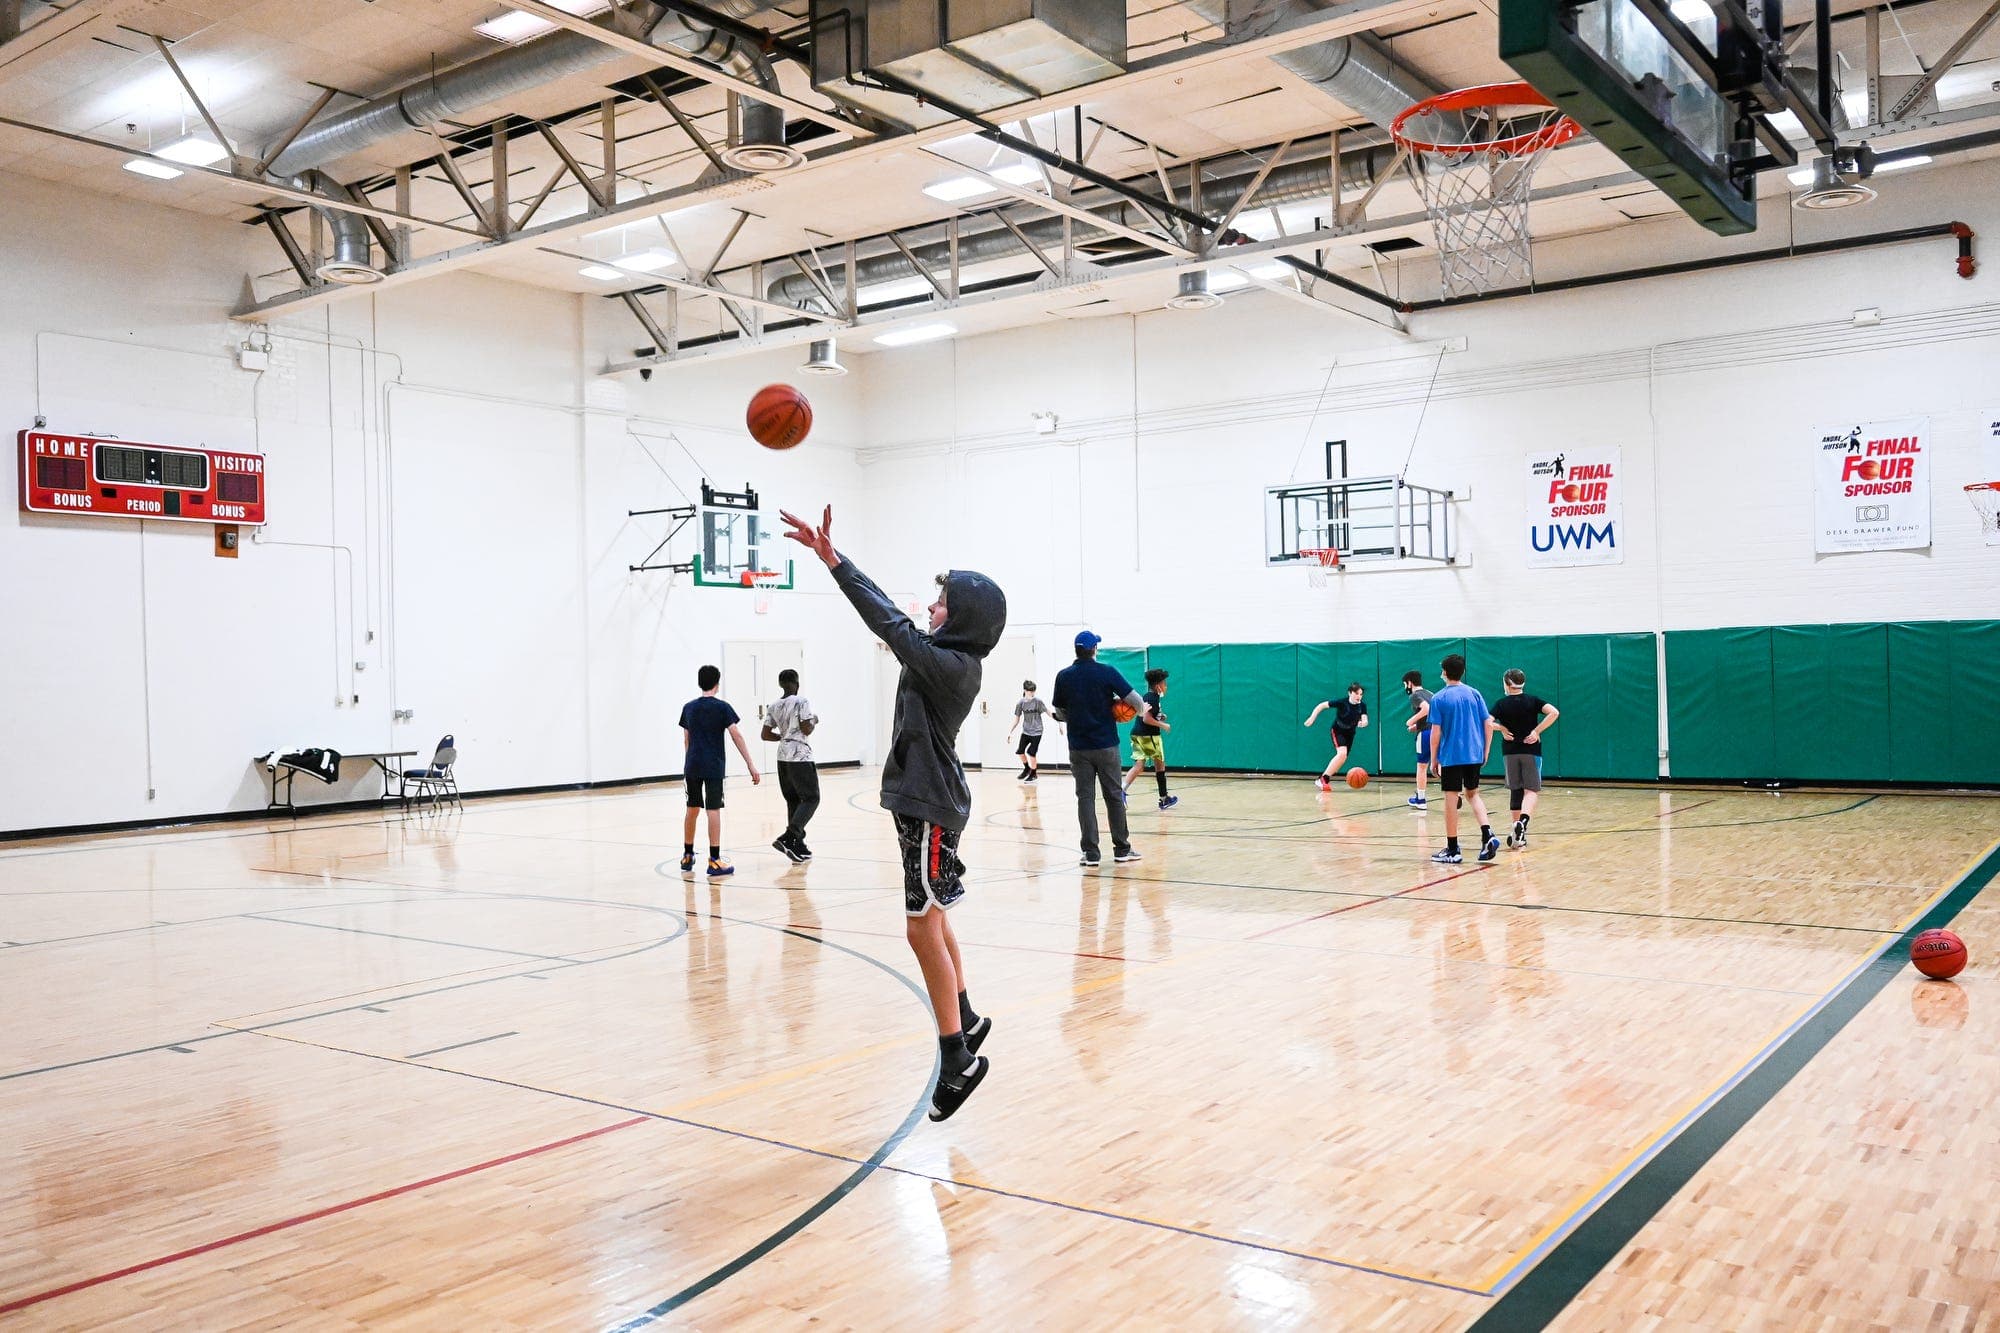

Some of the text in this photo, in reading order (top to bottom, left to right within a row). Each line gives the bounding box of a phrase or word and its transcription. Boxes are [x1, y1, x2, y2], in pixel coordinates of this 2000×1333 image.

[36, 438, 88, 457] HOME
[1823, 442, 1847, 450] HUTSON
[1866, 436, 1921, 456] FINAL
[214, 455, 262, 473] VISITOR
[1568, 463, 1614, 481] FINAL
[1841, 455, 1914, 482] FOUR
[1548, 479, 1608, 504] FOUR
[1844, 480, 1912, 497] SPONSOR
[54, 493, 92, 508] BONUS
[127, 499, 161, 513] PERIOD
[212, 504, 246, 518] BONUS
[1551, 503, 1606, 518] SPONSOR
[1532, 521, 1615, 552] UWM
[1854, 526, 1892, 534] DRAWER
[1896, 524, 1920, 532] FUND
